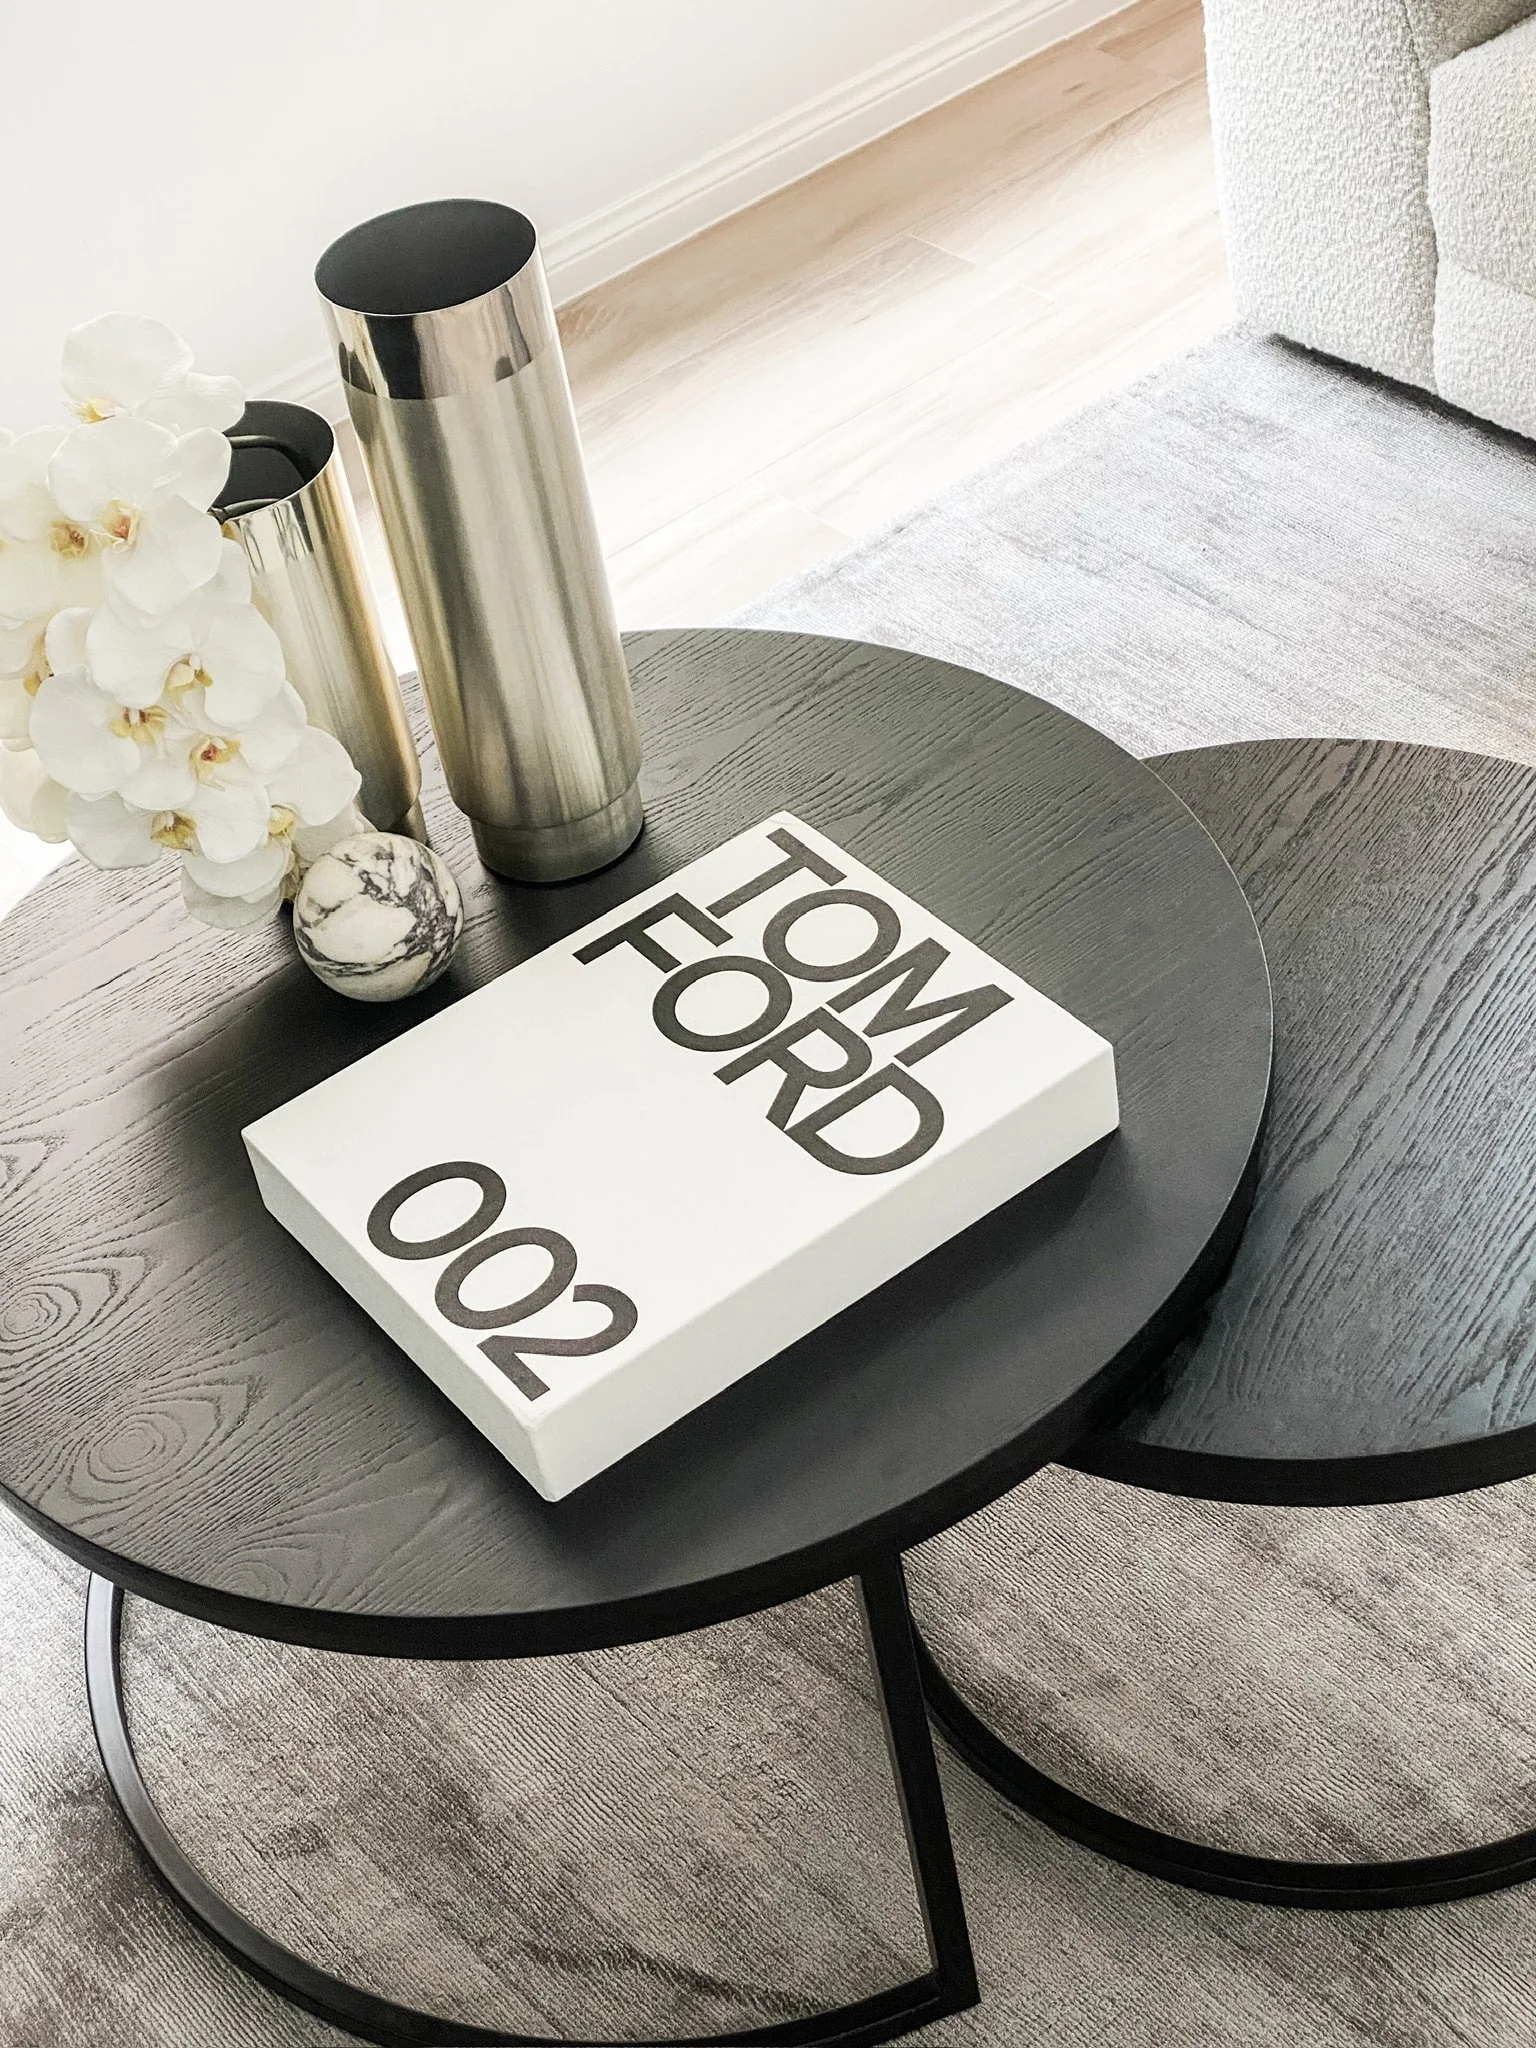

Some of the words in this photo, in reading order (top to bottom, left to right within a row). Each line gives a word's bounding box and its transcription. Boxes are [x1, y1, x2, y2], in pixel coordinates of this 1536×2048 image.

[571, 892, 945, 1176] FORD
[705, 827, 1015, 1068] TOM
[366, 1161, 639, 1402] 002
